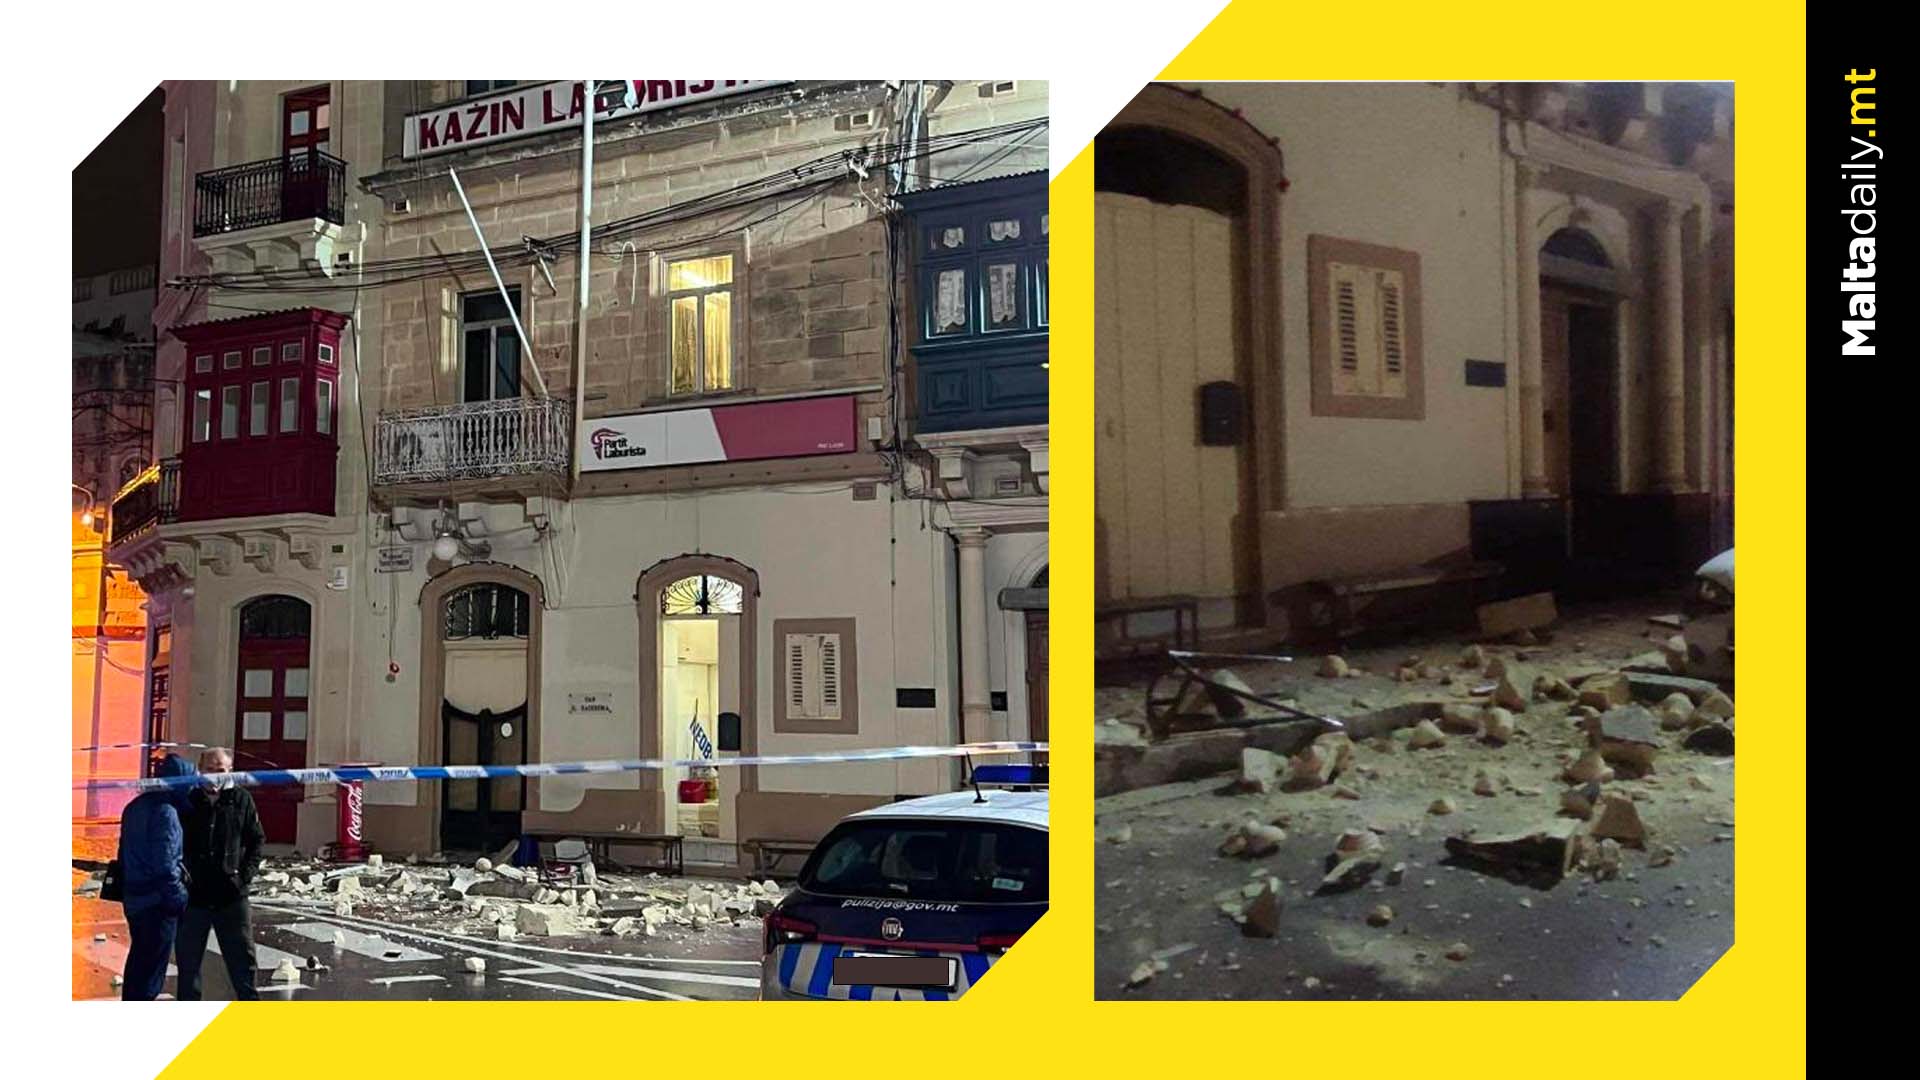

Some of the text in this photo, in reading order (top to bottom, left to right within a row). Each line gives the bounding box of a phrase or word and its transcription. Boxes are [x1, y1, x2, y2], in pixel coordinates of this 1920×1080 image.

[419, 96, 525, 151] KAŻIN
[603, 437, 628, 449] Partit
[603, 446, 647, 459] Laburista
